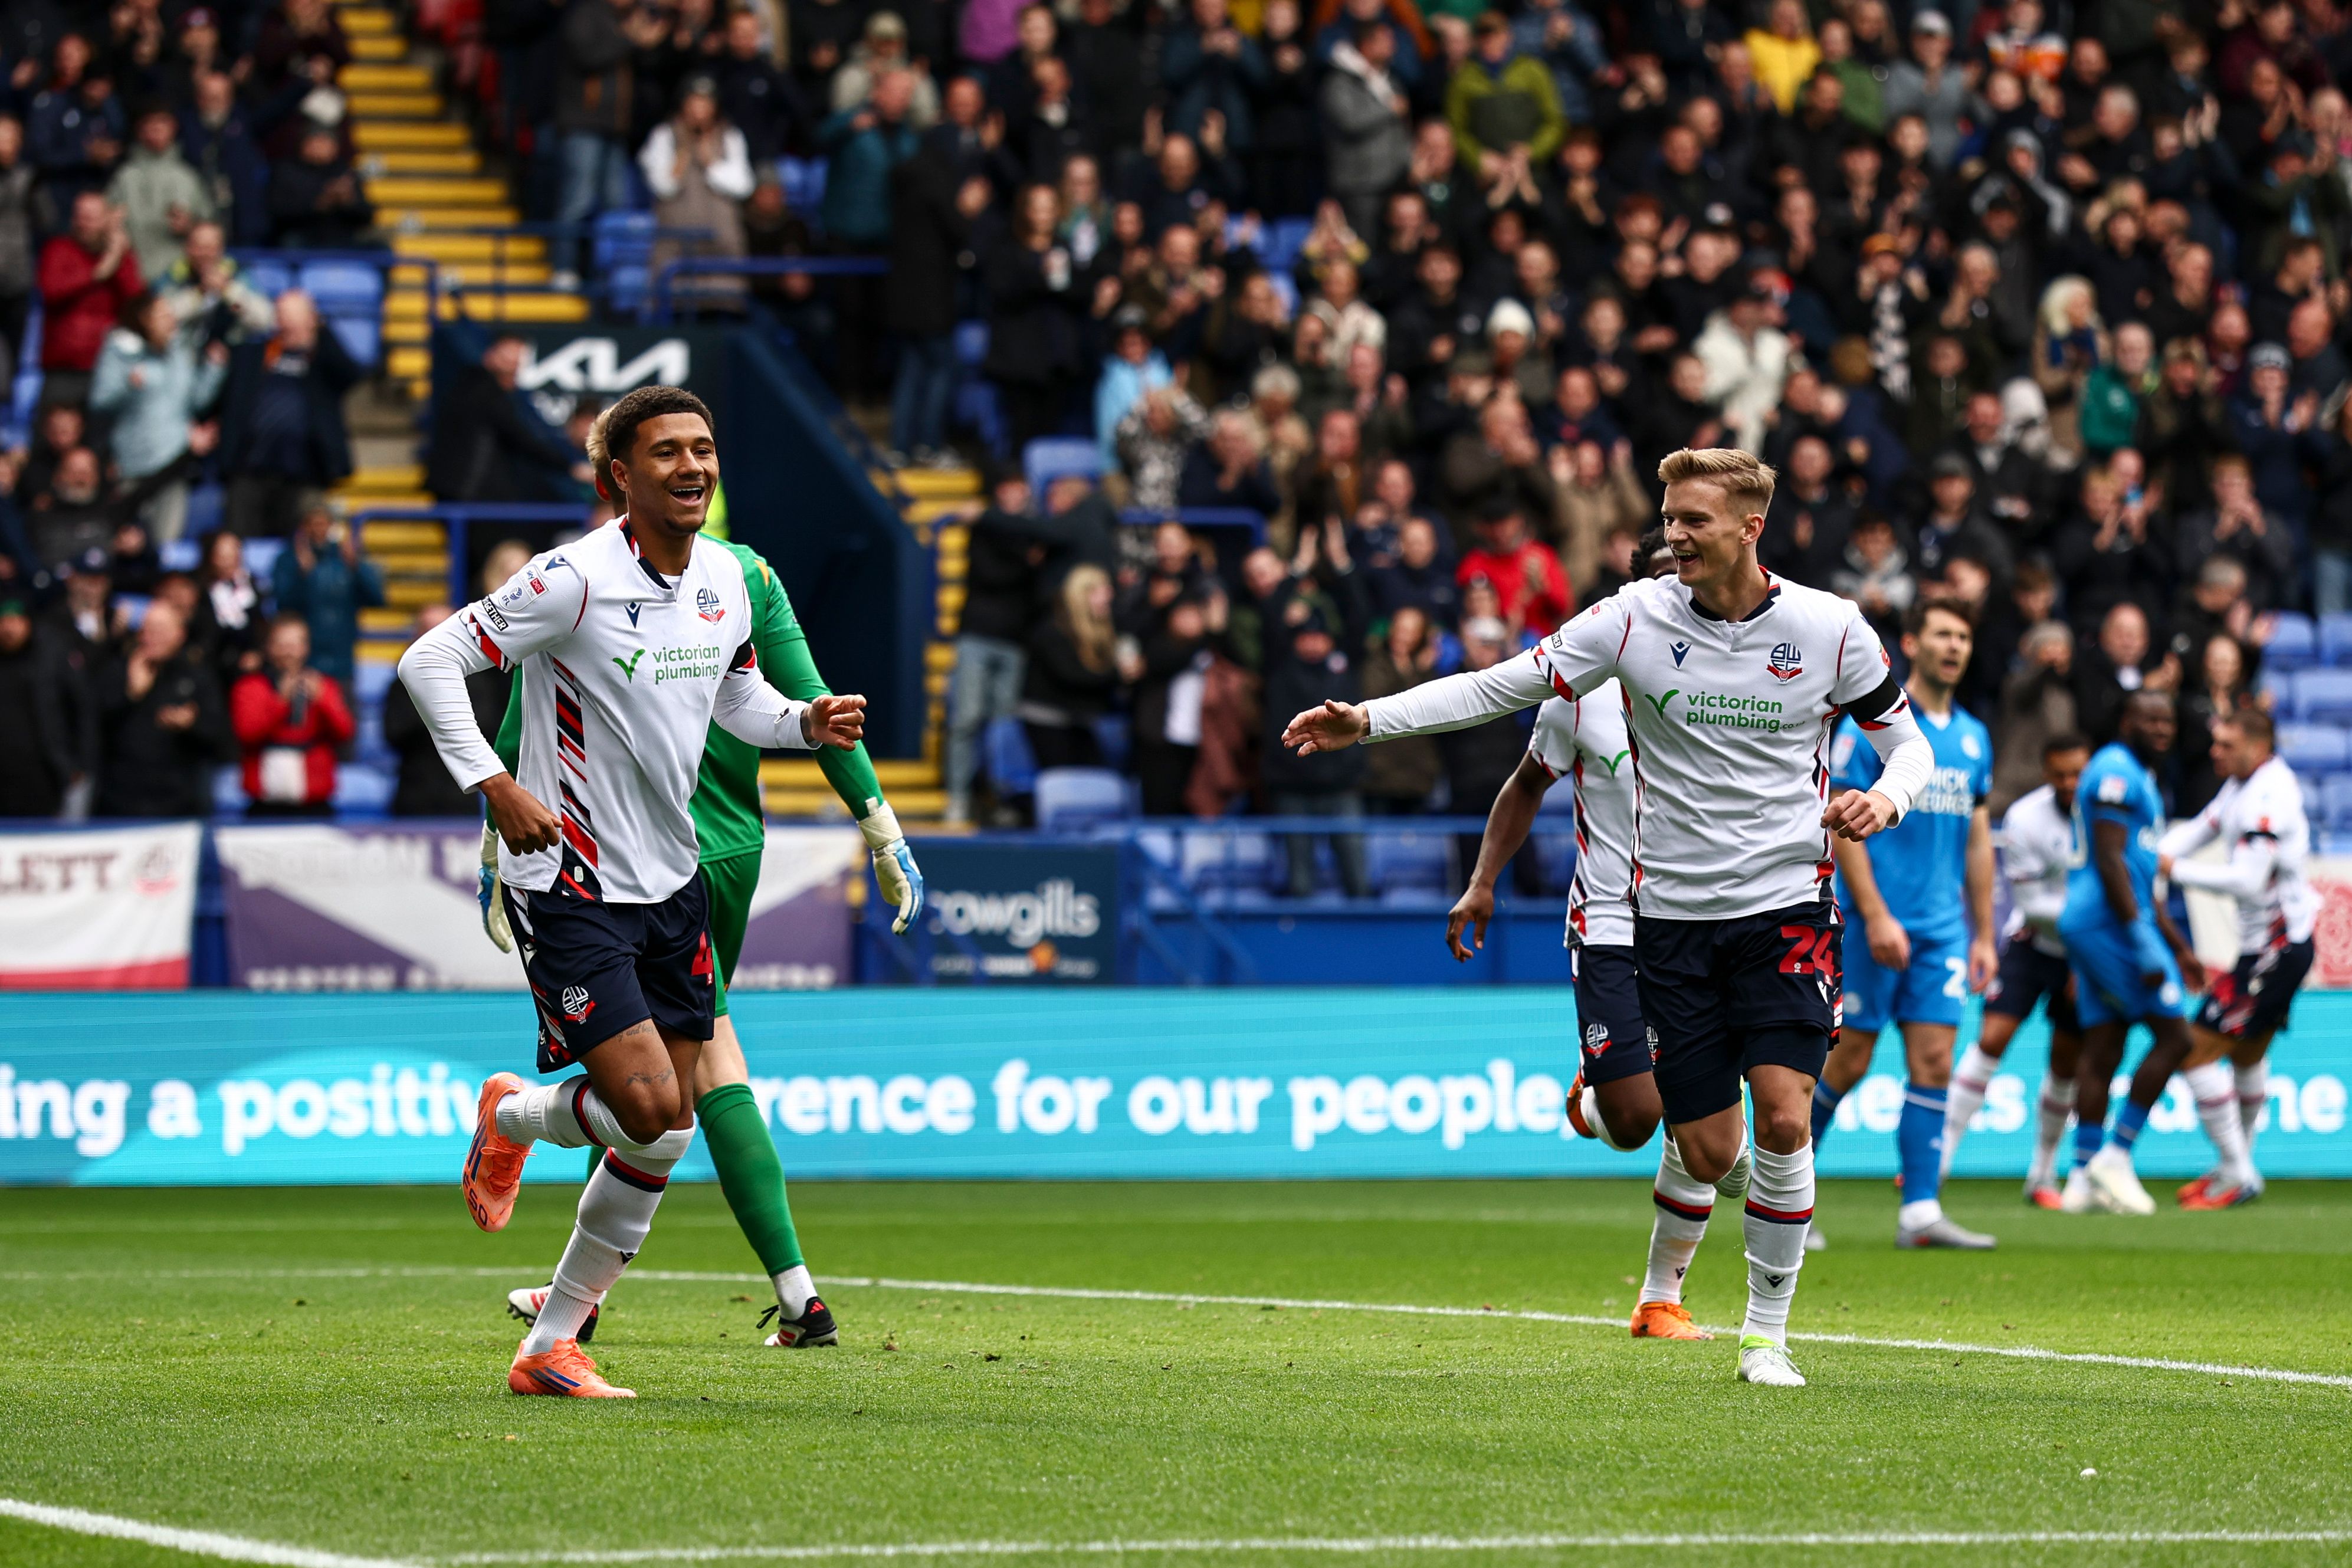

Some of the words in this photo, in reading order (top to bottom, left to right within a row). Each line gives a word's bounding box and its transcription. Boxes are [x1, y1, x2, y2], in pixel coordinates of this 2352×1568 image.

[481, 596, 507, 629] GETHER
[652, 644, 720, 662] victorian
[655, 662, 719, 684] plumbing
[1687, 691, 1782, 713] victorian
[1779, 925, 1835, 987] 24
[147, 1079, 202, 1138] a
[218, 1062, 479, 1156] positiv
[992, 1059, 1112, 1134] for
[1127, 1075, 1273, 1135] our
